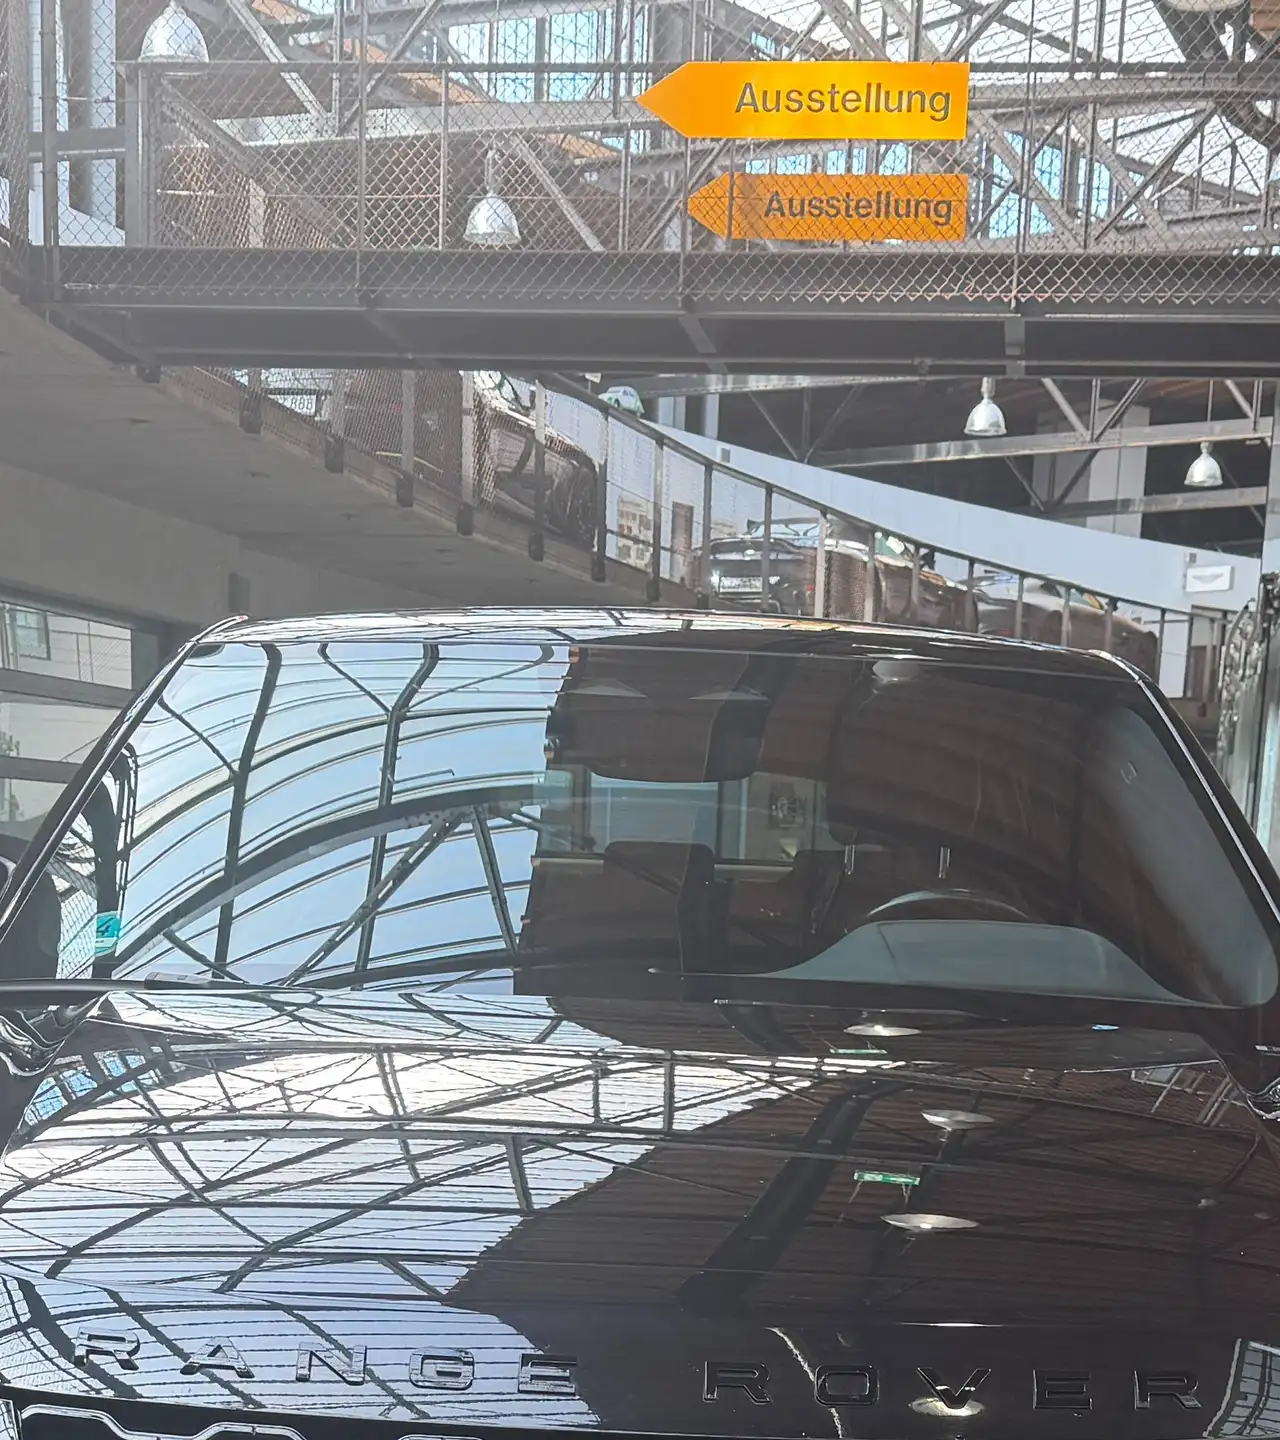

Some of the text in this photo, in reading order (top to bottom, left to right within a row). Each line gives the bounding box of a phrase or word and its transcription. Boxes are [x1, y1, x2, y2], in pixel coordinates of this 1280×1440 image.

[734, 82, 952, 122] Ausstellung
[764, 190, 953, 227] Ausstellung
[73, 1326, 1202, 1411] RANGE ROVER
